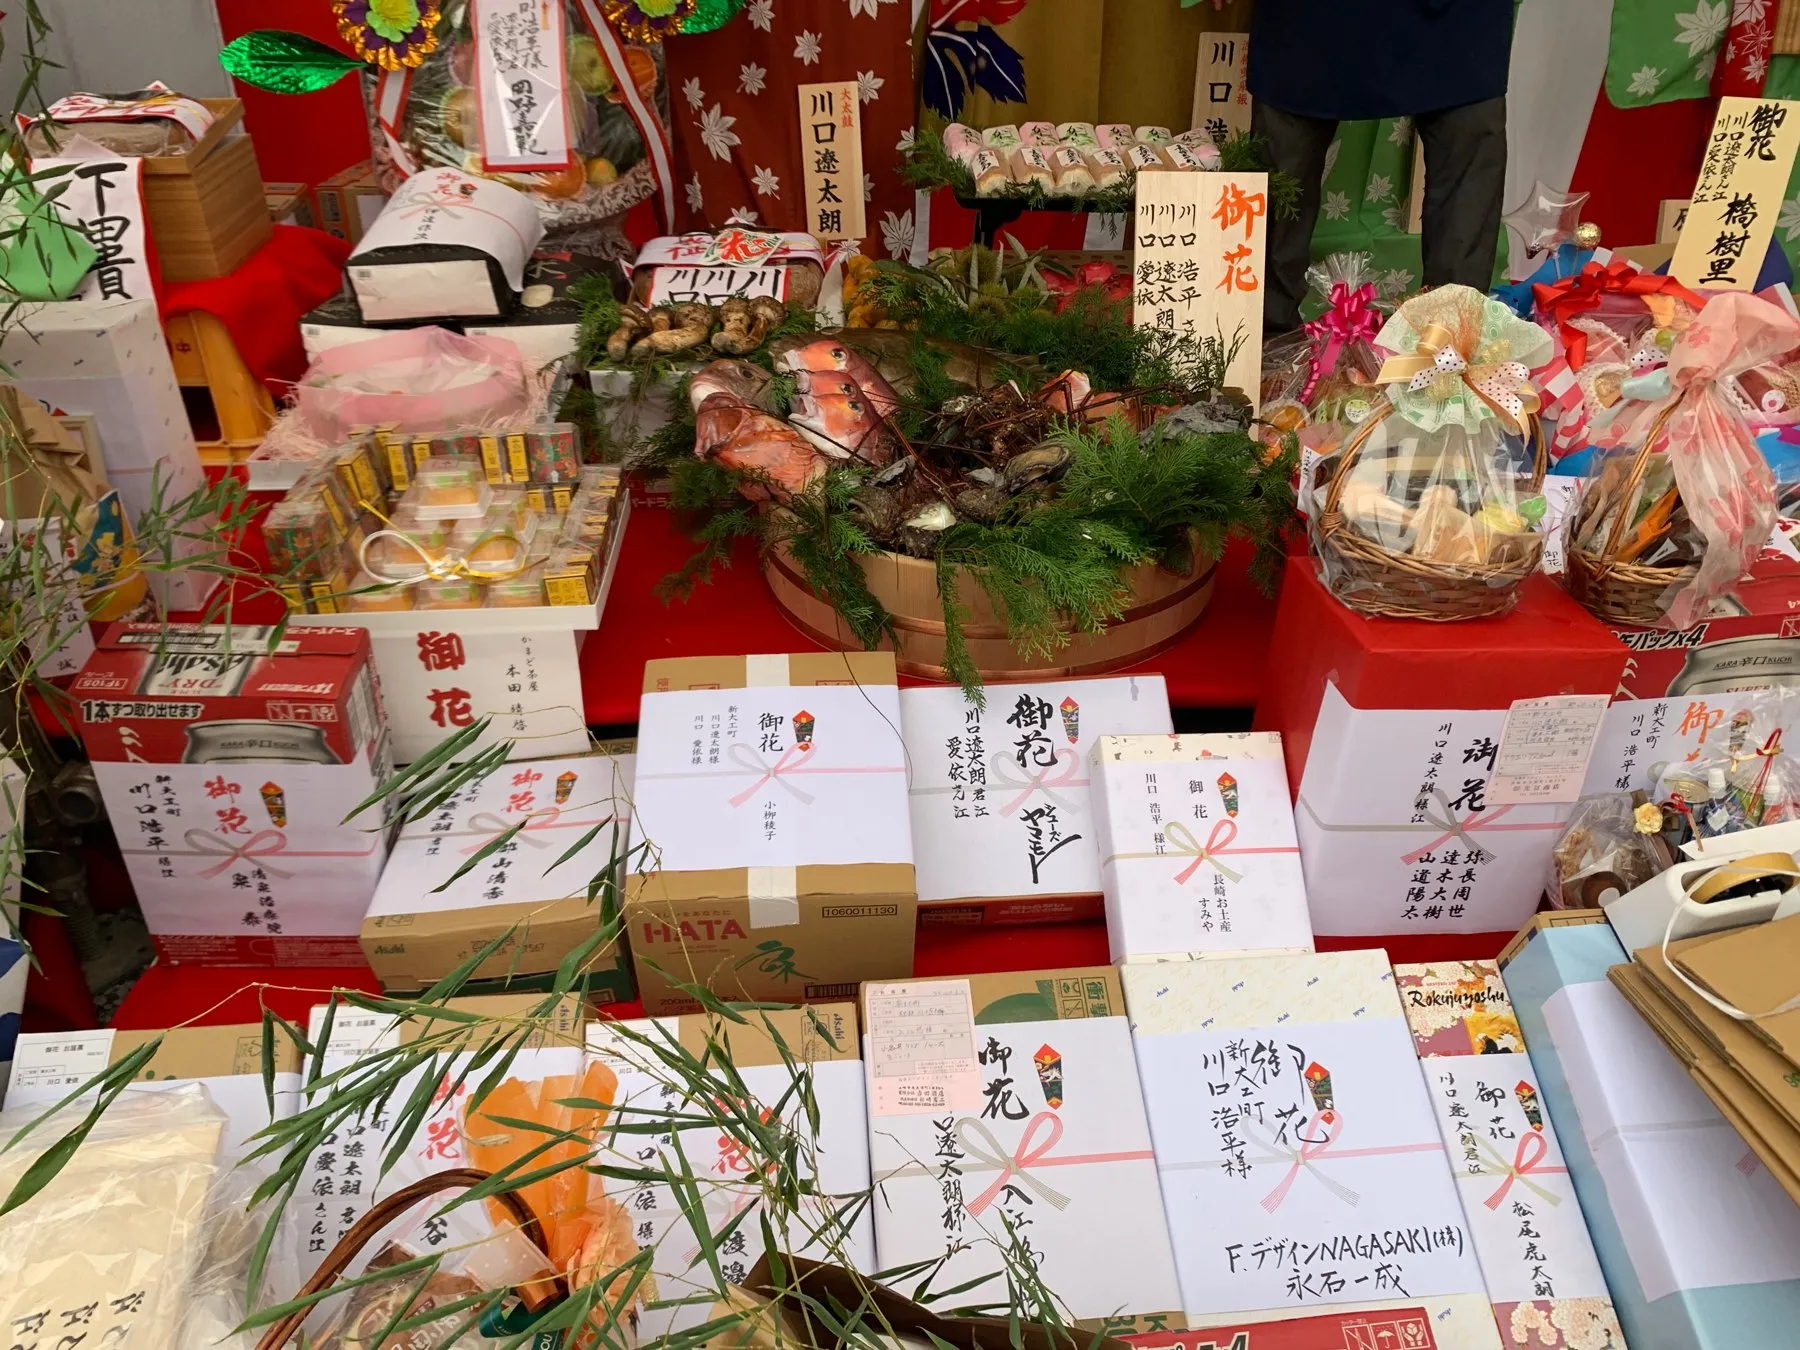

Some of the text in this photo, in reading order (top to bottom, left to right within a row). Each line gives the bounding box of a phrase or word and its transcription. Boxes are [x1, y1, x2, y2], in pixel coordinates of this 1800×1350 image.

[840, 88, 854, 128] 大太鼓
[1744, 103, 1787, 161] 御花
[1211, 182, 1266, 295] 御花
[157, 653, 247, 677] Asahi
[416, 631, 477, 728] 御花
[1714, 660, 1738, 669] KARA
[1740, 656, 1767, 667] 辛口
[81, 701, 202, 721] 1本ずつ取り出せます
[727, 705, 738, 738] 新大工町
[1007, 693, 1058, 768] 御花
[1646, 702, 1668, 749] 新大工町
[758, 712, 784, 753] 御花
[1673, 701, 1725, 764] 御
[501, 768, 543, 812] 御花
[1448, 737, 1500, 812] 御花
[203, 775, 253, 835] 御花
[1189, 780, 1208, 819] 御花
[824, 906, 895, 917] 1060011130
[1199, 897, 1214, 932] すみや
[1213, 874, 1231, 933] 長崎お土産
[643, 919, 748, 944] HATA
[1408, 986, 1505, 1008] Rokujuyoshu
[978, 1036, 1030, 1121] 御花
[1475, 1081, 1516, 1140] 御花
[1286, 1262, 1411, 1300] 永石一成
